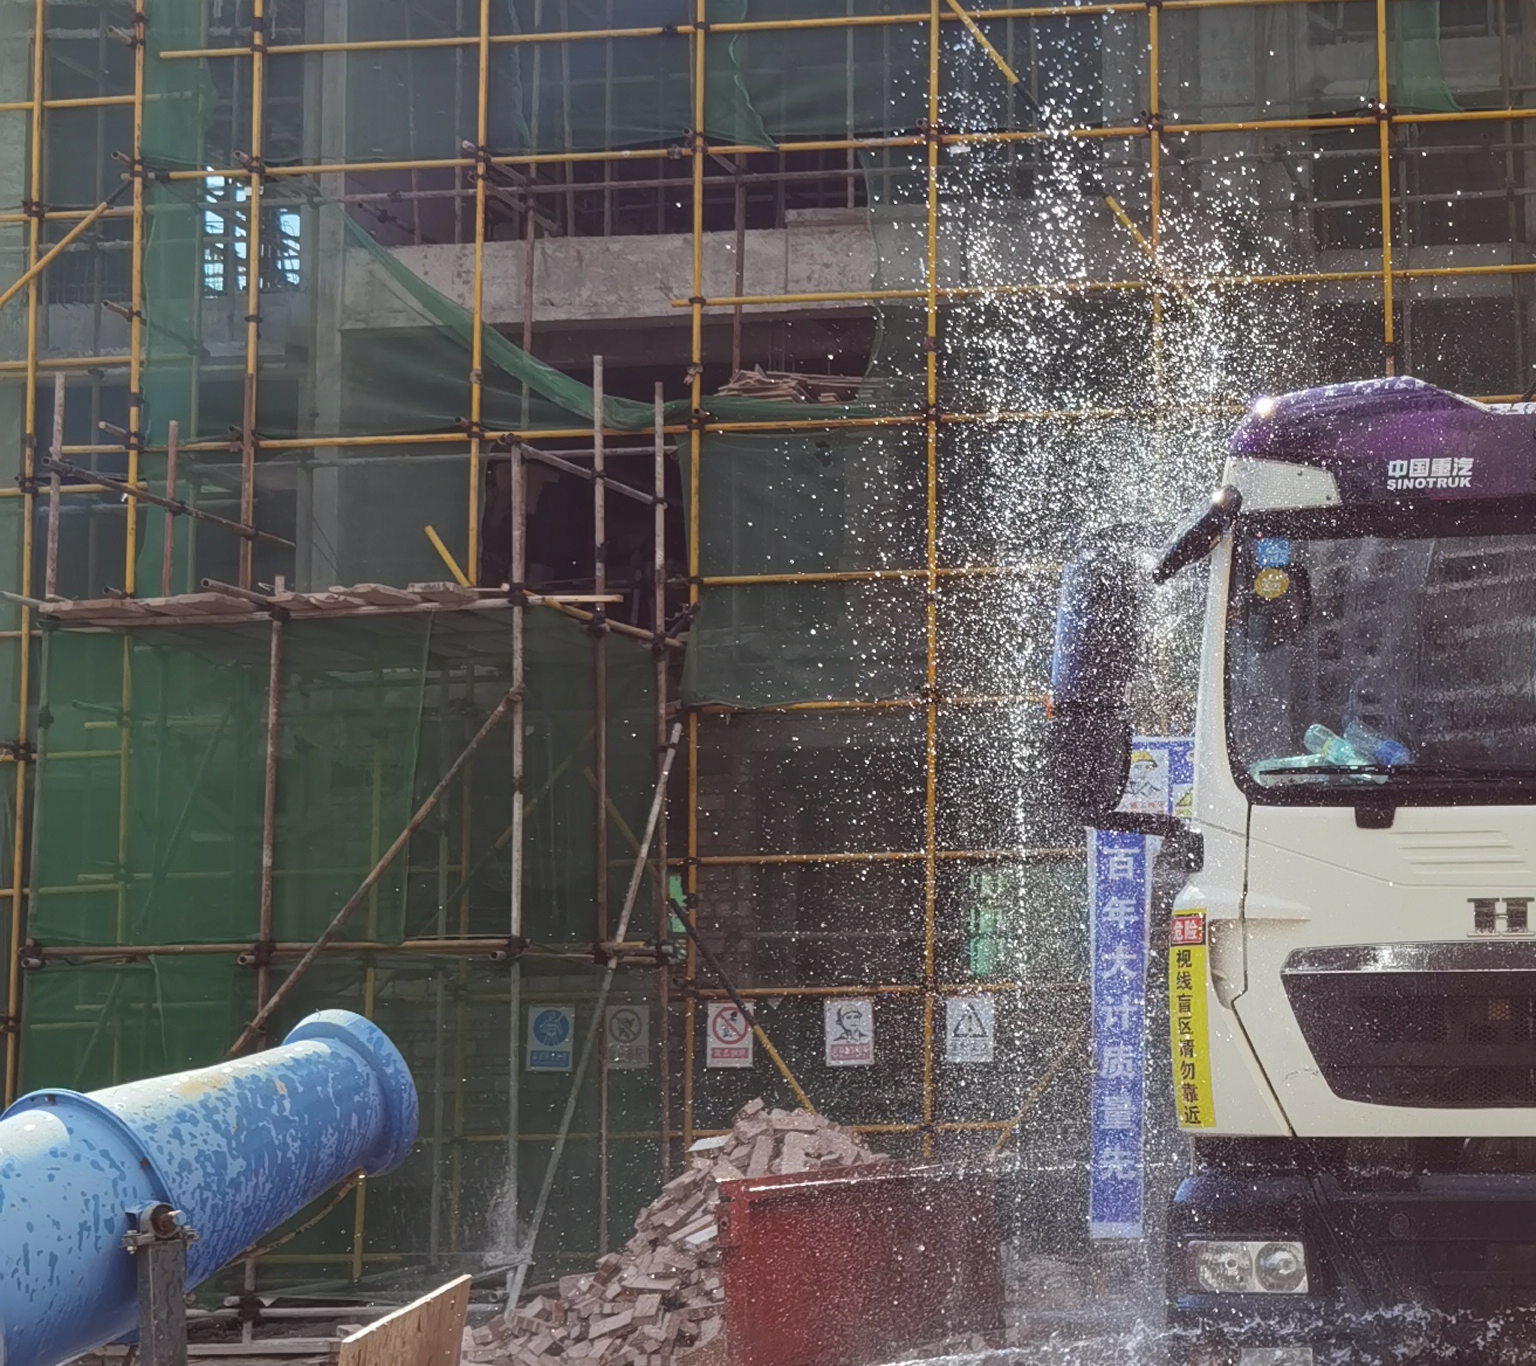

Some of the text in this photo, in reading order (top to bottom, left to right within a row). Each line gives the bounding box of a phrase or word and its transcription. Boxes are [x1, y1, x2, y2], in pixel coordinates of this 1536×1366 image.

[1387, 457, 1474, 477] 中国重汽
[1386, 477, 1472, 491] SINOTRUK
[1172, 919, 1199, 941] 危险
[1100, 846, 1140, 1180] 百年大计质量先
[1175, 949, 1201, 1125] 视线盲区请勿靠近
